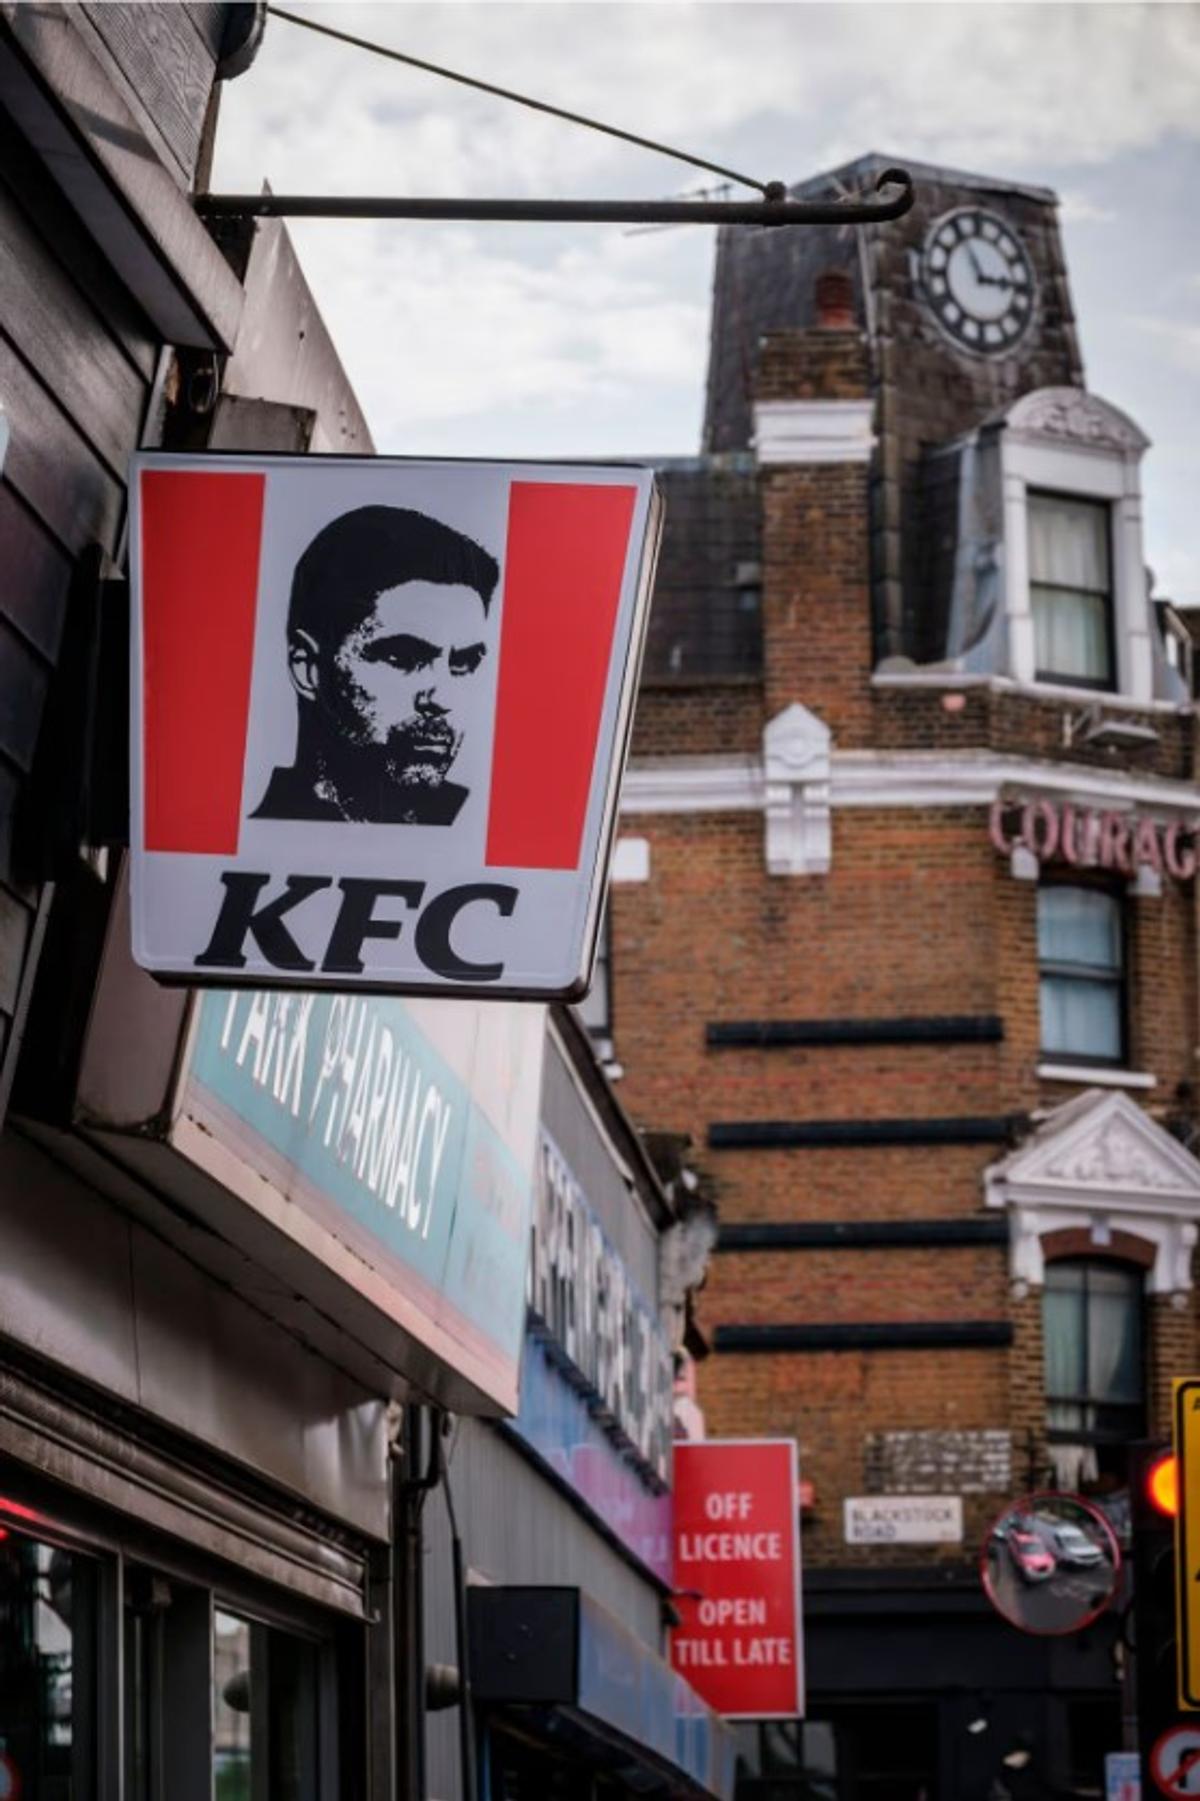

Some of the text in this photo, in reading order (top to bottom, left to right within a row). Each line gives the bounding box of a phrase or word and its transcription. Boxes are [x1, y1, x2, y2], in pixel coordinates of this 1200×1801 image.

[989, 797, 1200, 880] COURAG
[193, 871, 520, 982] KFC
[308, 991, 450, 1240] PHARMACY
[705, 1493, 753, 1520] OFF
[852, 1507, 952, 1522] BLACKSTOCK
[852, 1523, 897, 1537] ROAD
[679, 1532, 782, 1561] LICENCE
[699, 1598, 767, 1626] OPEN
[674, 1637, 792, 1666] TILL LATE
